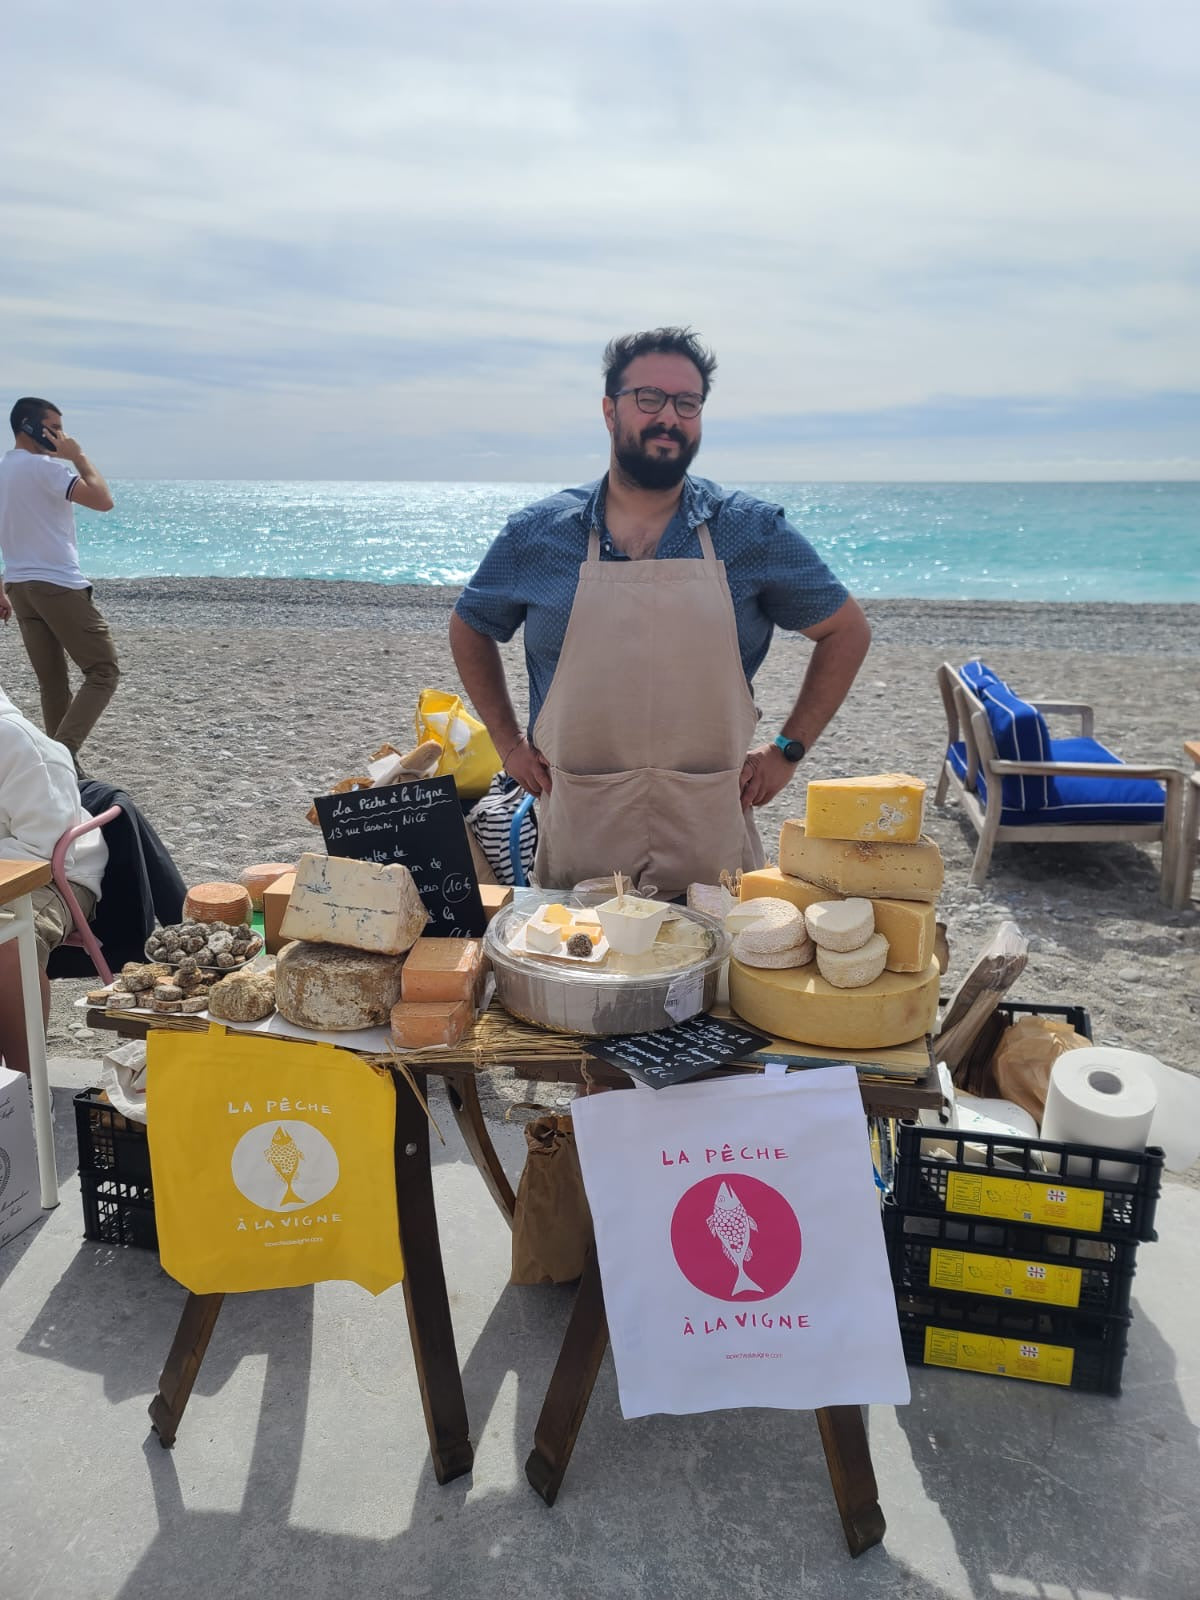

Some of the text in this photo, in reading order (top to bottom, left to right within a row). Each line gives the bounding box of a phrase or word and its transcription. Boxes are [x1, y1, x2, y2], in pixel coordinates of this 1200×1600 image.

[332, 800, 353, 818] La
[389, 794, 399, 804] à
[401, 786, 412, 803] la
[413, 785, 448, 807] Vigne
[328, 828, 343, 840] 13
[345, 826, 361, 836] rue
[393, 845, 408, 857] de
[228, 1097, 332, 1114] LA PÊCHE
[662, 1143, 790, 1166] LA PÊCHE
[236, 1213, 343, 1231] À LA VIGNE
[683, 1312, 812, 1336] À LA VIGNE
